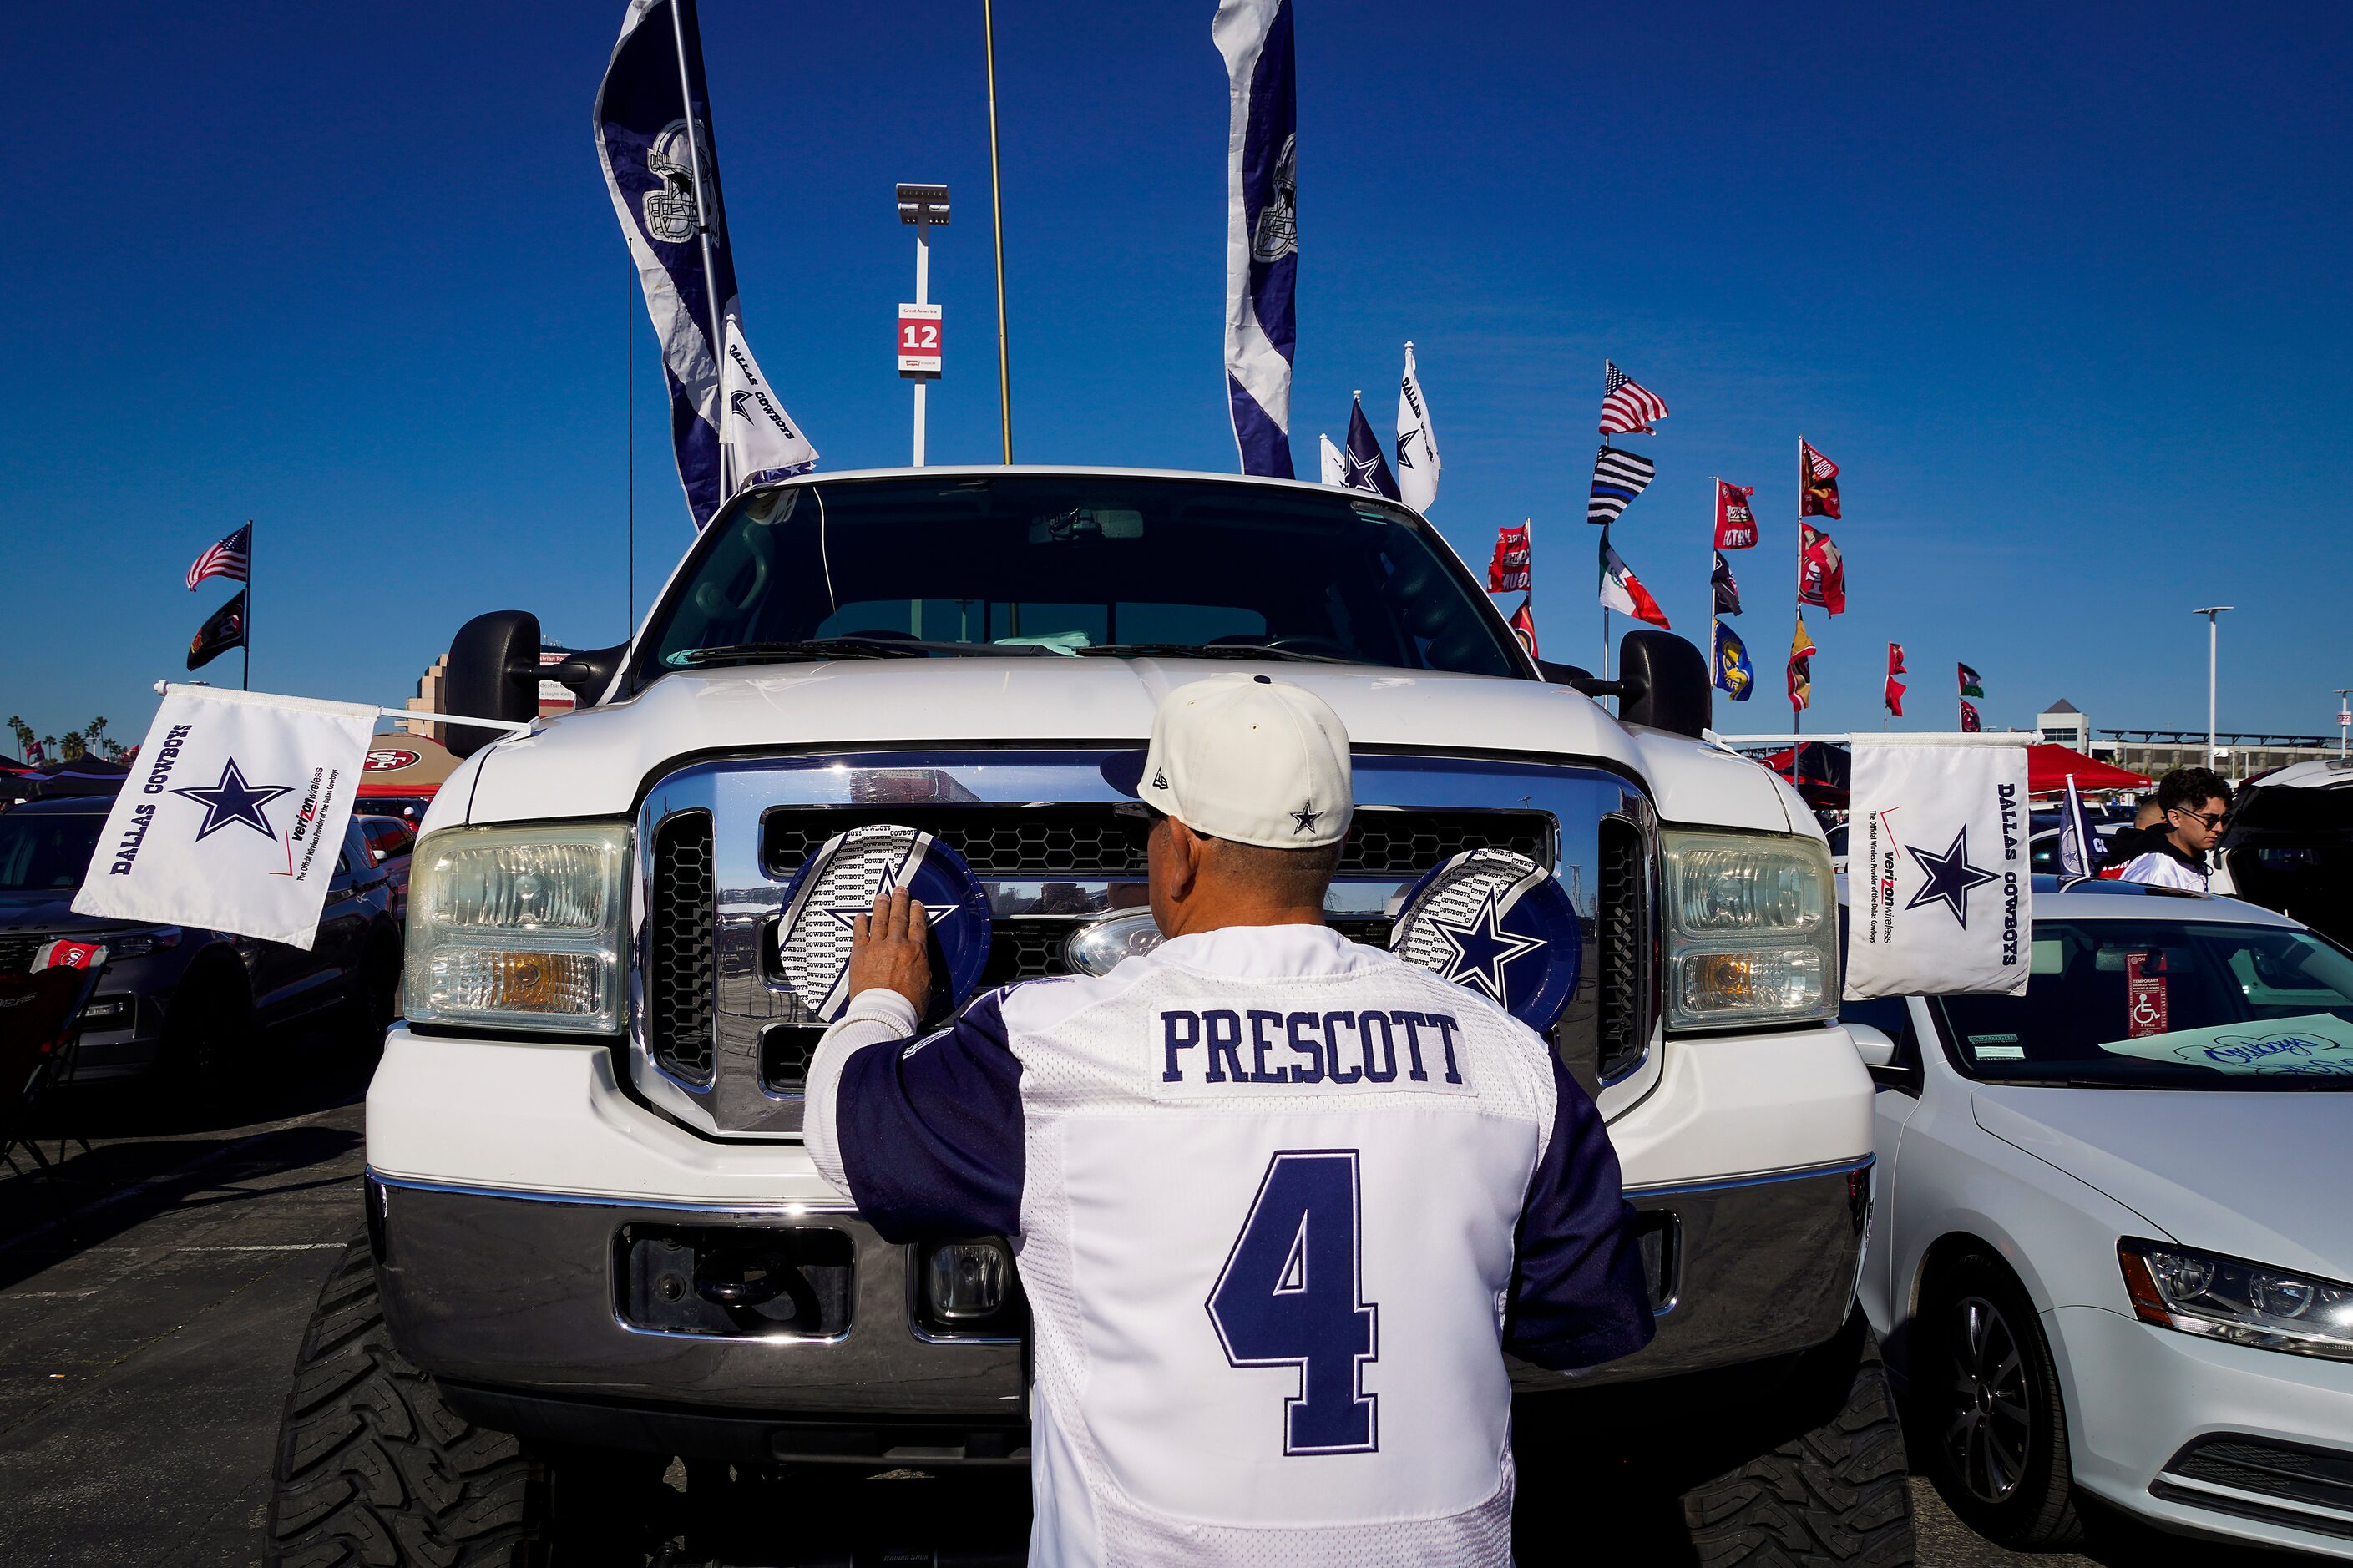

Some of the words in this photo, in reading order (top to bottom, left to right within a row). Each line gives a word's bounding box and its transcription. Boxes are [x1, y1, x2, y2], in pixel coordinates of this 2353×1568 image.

[903, 326, 938, 348] 12
[729, 343, 758, 386] DALLAS
[754, 391, 796, 440] COWBOYS
[326, 769, 340, 791] Cowboys
[109, 804, 156, 875] DALLAS
[144, 725, 193, 794] COWBOYS
[322, 790, 333, 804] Dallas
[313, 819, 325, 837] Provider
[1997, 783, 2017, 861] DALLAS
[306, 835, 320, 856] Wireless
[301, 854, 313, 871] Official
[296, 872, 307, 882] The
[1441, 897, 1470, 908] COWBOYS
[1443, 887, 1471, 898] COWBOYS
[1439, 907, 1467, 918] COWBOYS
[2002, 872, 2018, 967] COWBOYS
[1869, 919, 1878, 943] Cowboys
[1161, 1009, 1463, 1084] PRESCOTT
[1204, 1148, 1379, 1457] 4
